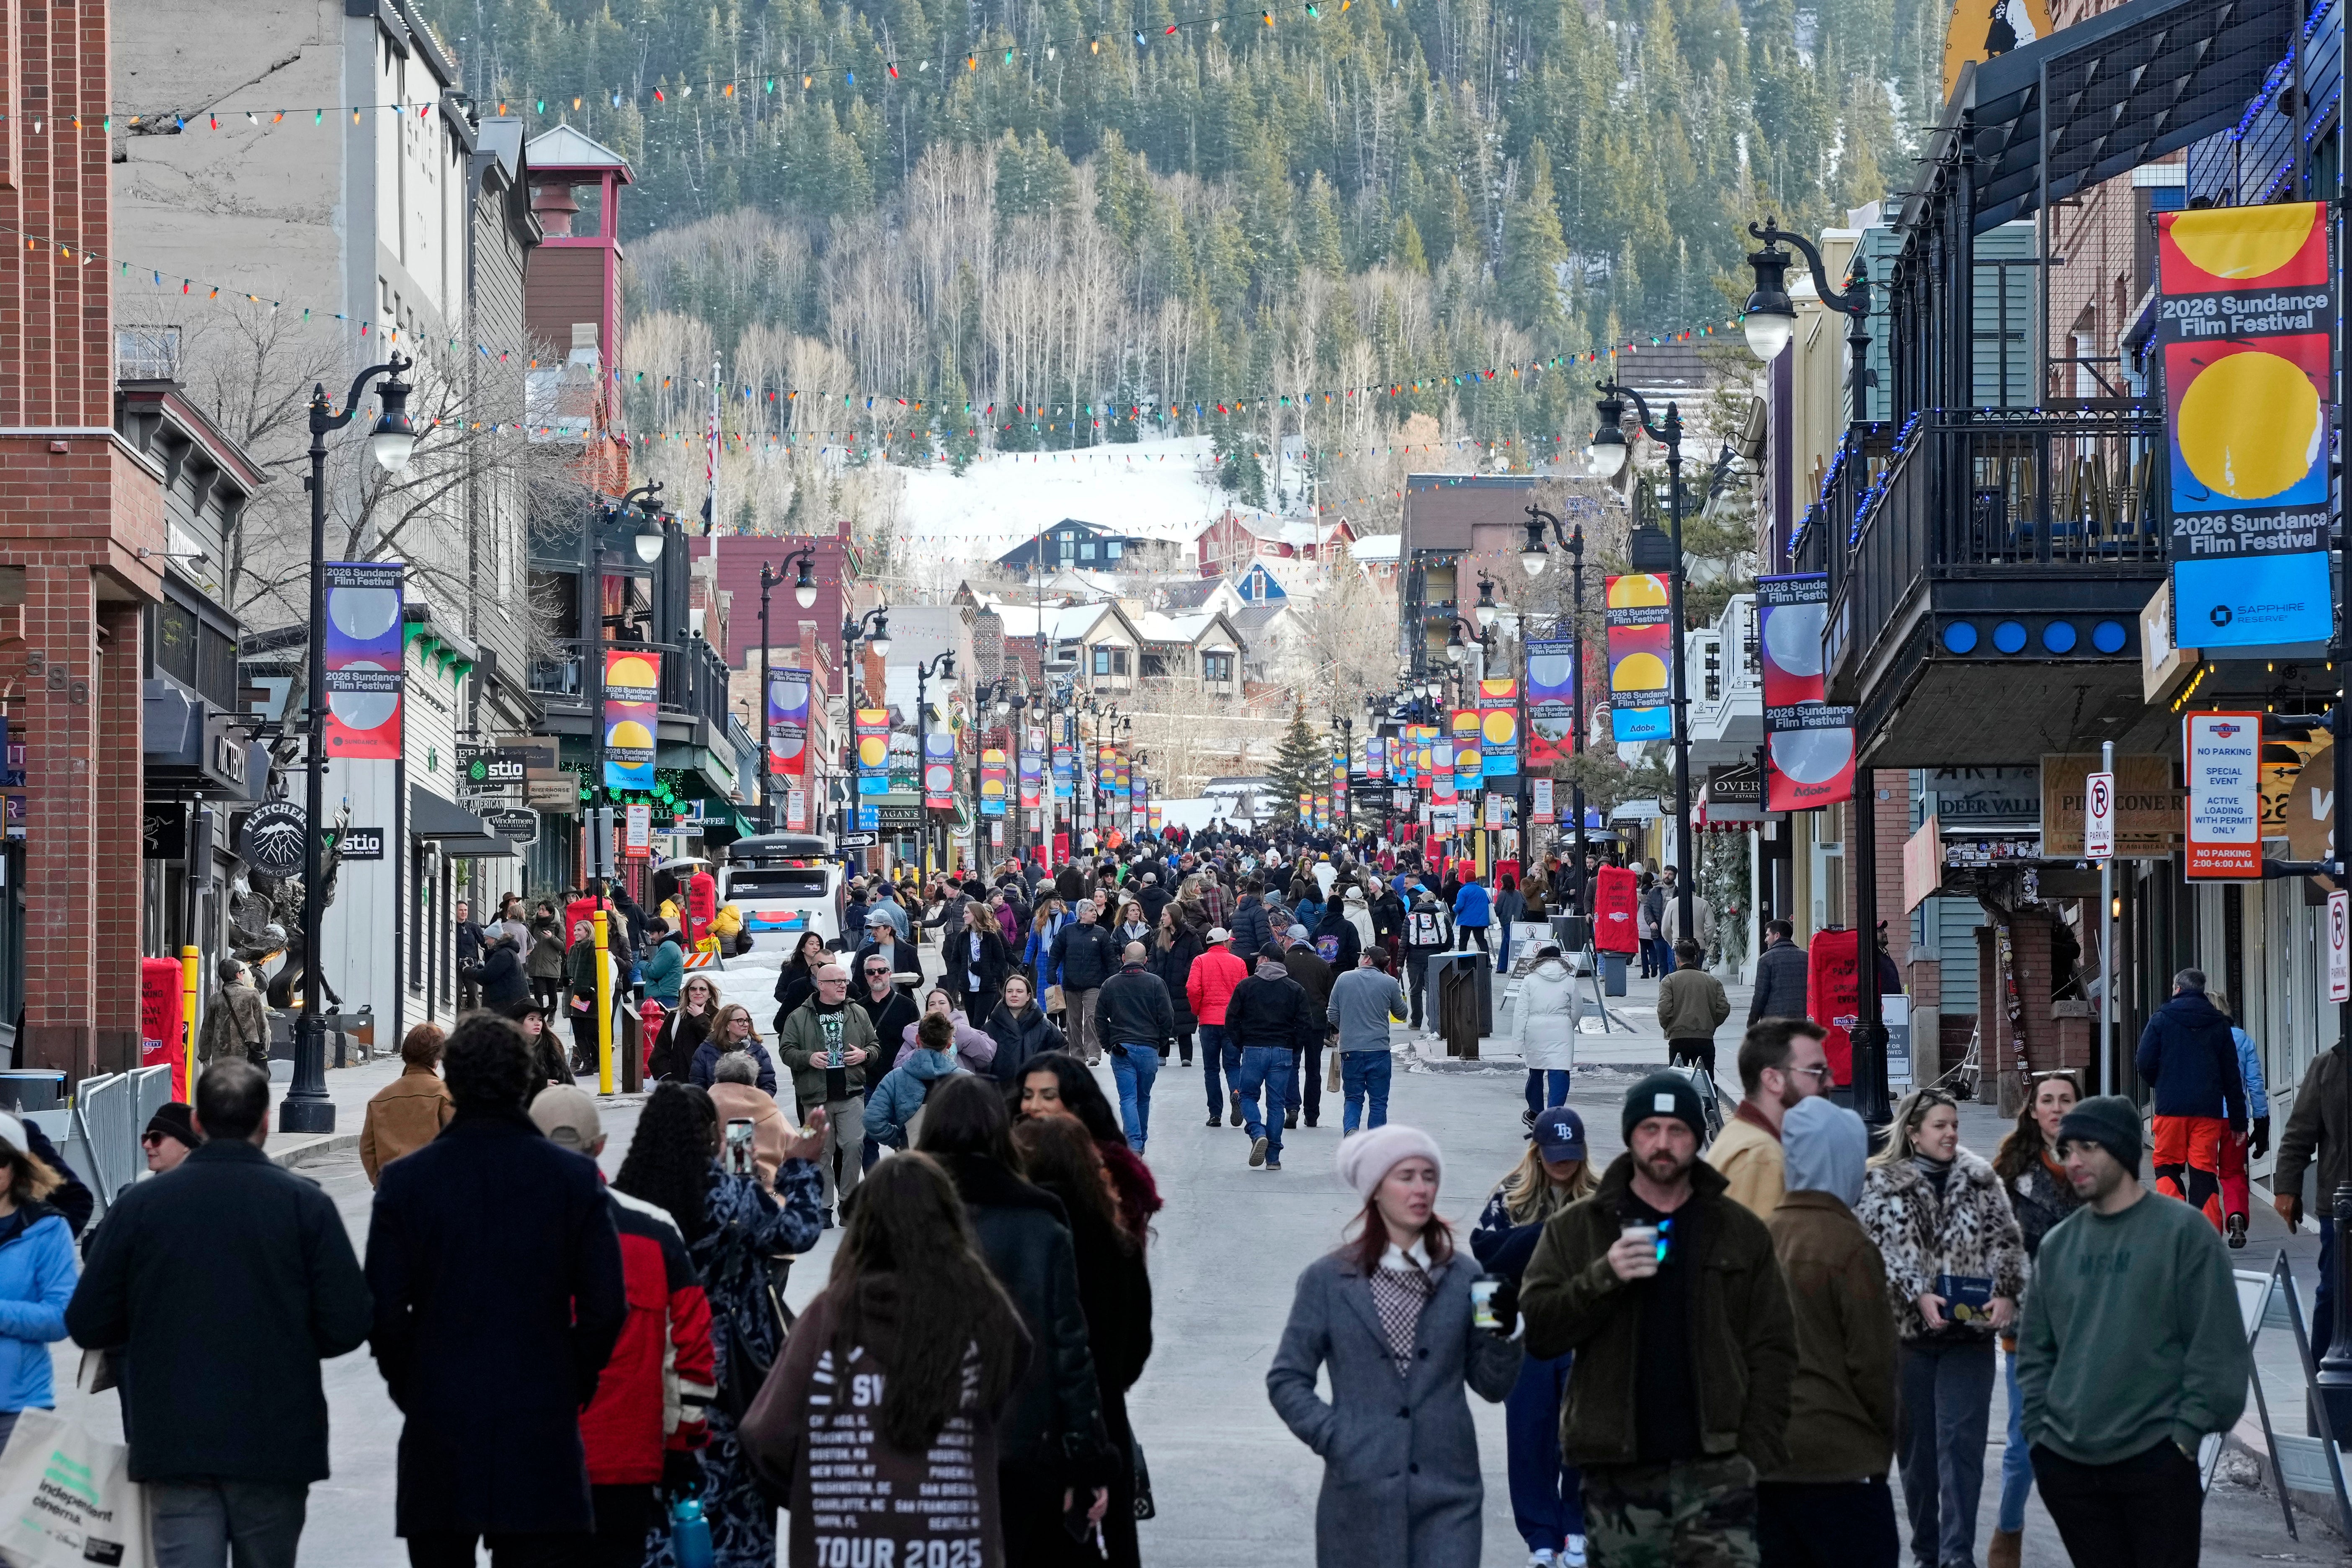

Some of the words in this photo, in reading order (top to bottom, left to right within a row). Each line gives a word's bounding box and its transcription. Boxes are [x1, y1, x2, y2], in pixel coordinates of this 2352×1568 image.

[2163, 298, 2217, 319] 2026
[2221, 293, 2328, 314] Sundance
[2181, 317, 2226, 336] Film
[2231, 310, 2313, 333] Festival
[2173, 516, 2227, 536] 2026
[2231, 512, 2327, 532] Sundance
[2191, 535, 2236, 554] Film
[2241, 529, 2317, 551] Festival
[327, 568, 350, 577] 2026
[353, 569, 402, 578] Sundance
[335, 577, 355, 585] Film
[357, 577, 394, 586] Festival
[1759, 583, 1787, 593] 2026
[1790, 580, 1827, 591] Sunda
[1769, 593, 1793, 603] Film
[1796, 590, 1827, 601] Festiv
[2238, 603, 2305, 614] SAPPHIRE
[26, 650, 89, 704] 580
[326, 672, 350, 681] 2026
[352, 673, 401, 681] Sundance
[333, 681, 353, 689] Film
[356, 681, 393, 690] Festival
[1637, 697, 1664, 706] Festival
[1767, 708, 1795, 719] 2026
[1797, 706, 1854, 717] Sundance
[1776, 718, 1799, 728] Film
[1802, 714, 1846, 726] Festival
[218, 735, 245, 785] ARC'TERYX
[488, 761, 523, 776] stio
[1715, 781, 1760, 792] OVER
[1794, 786, 1831, 797] Adobe
[469, 800, 504, 809] AMERICAN
[1940, 800, 1989, 813] DEER
[242, 803, 307, 833] FLETCHER
[343, 834, 379, 850] stio
[2089, 831, 2110, 841] PARKING
[2197, 849, 2209, 858] NO
[2210, 850, 2251, 858] PARKING
[255, 862, 275, 876] PARK
[294, 860, 304, 871] UT
[1553, 1123, 1573, 1140] TB
[814, 1536, 895, 1568] TOUR
[904, 1538, 982, 1568] 2025
